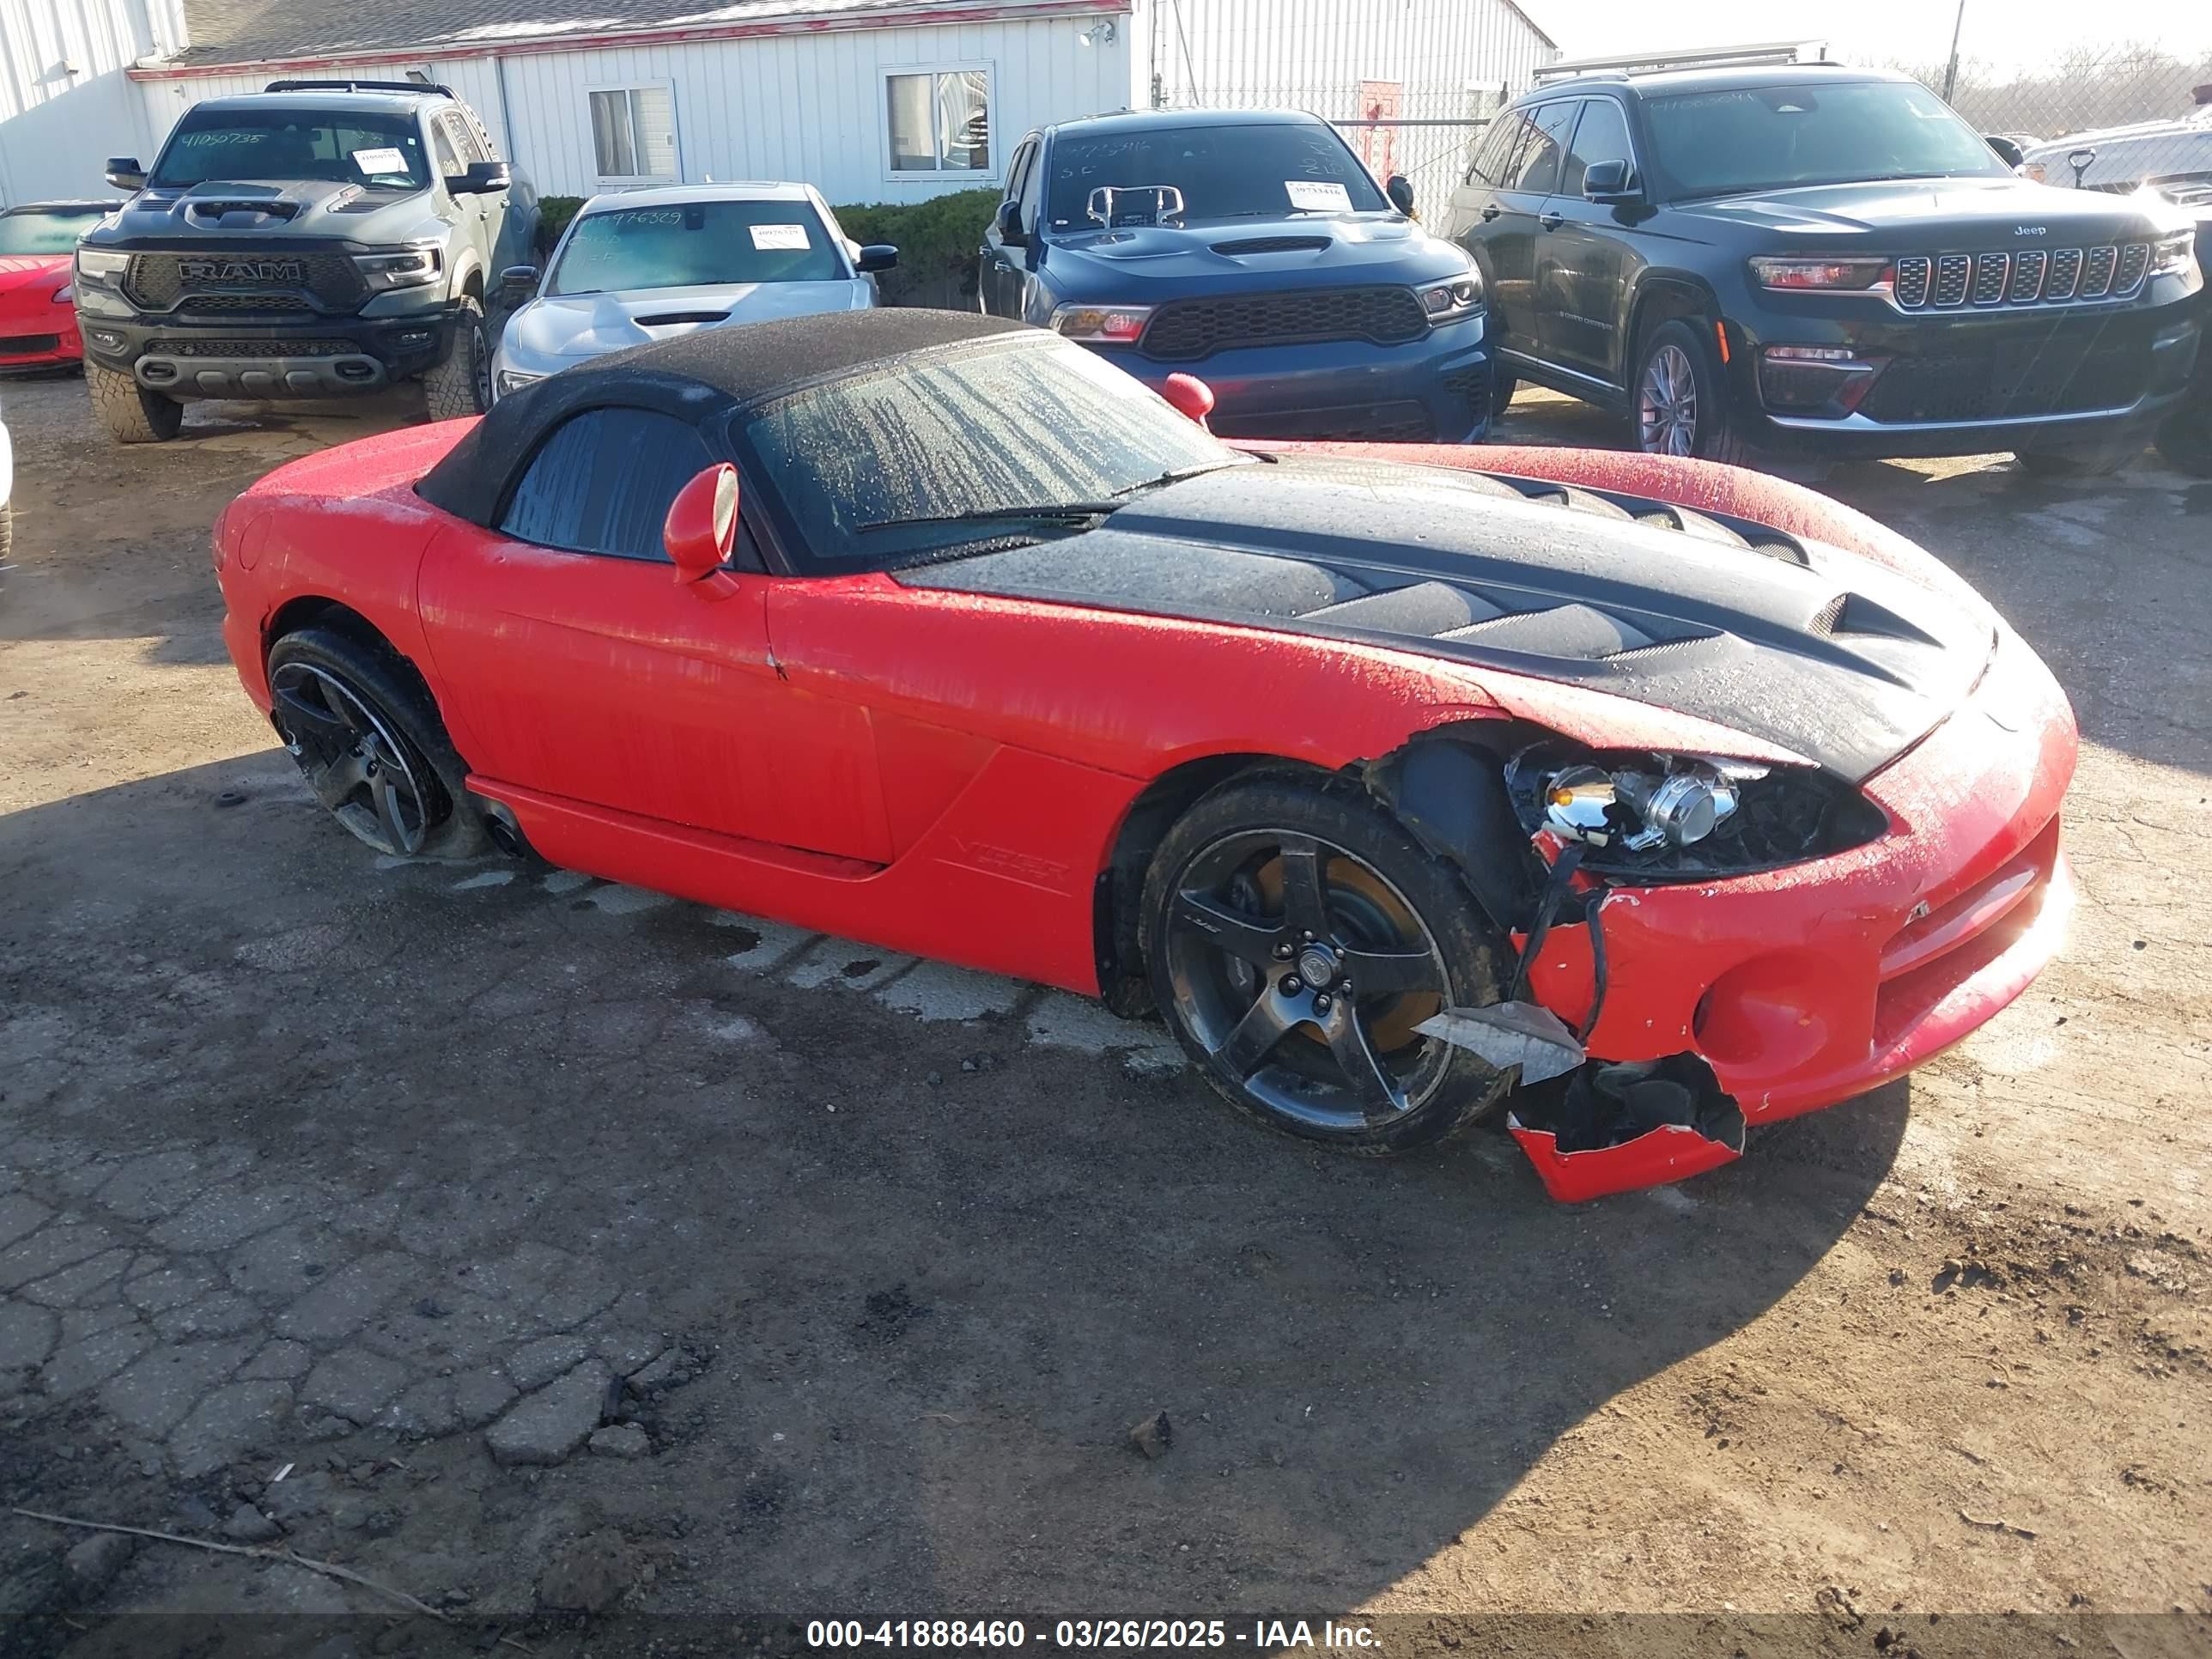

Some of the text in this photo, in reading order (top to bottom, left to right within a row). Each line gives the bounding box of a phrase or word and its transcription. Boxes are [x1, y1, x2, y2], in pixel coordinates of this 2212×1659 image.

[181, 132, 269, 148] 41050735
[2014, 226, 2047, 236] Jeep
[179, 262, 301, 280] RAM
